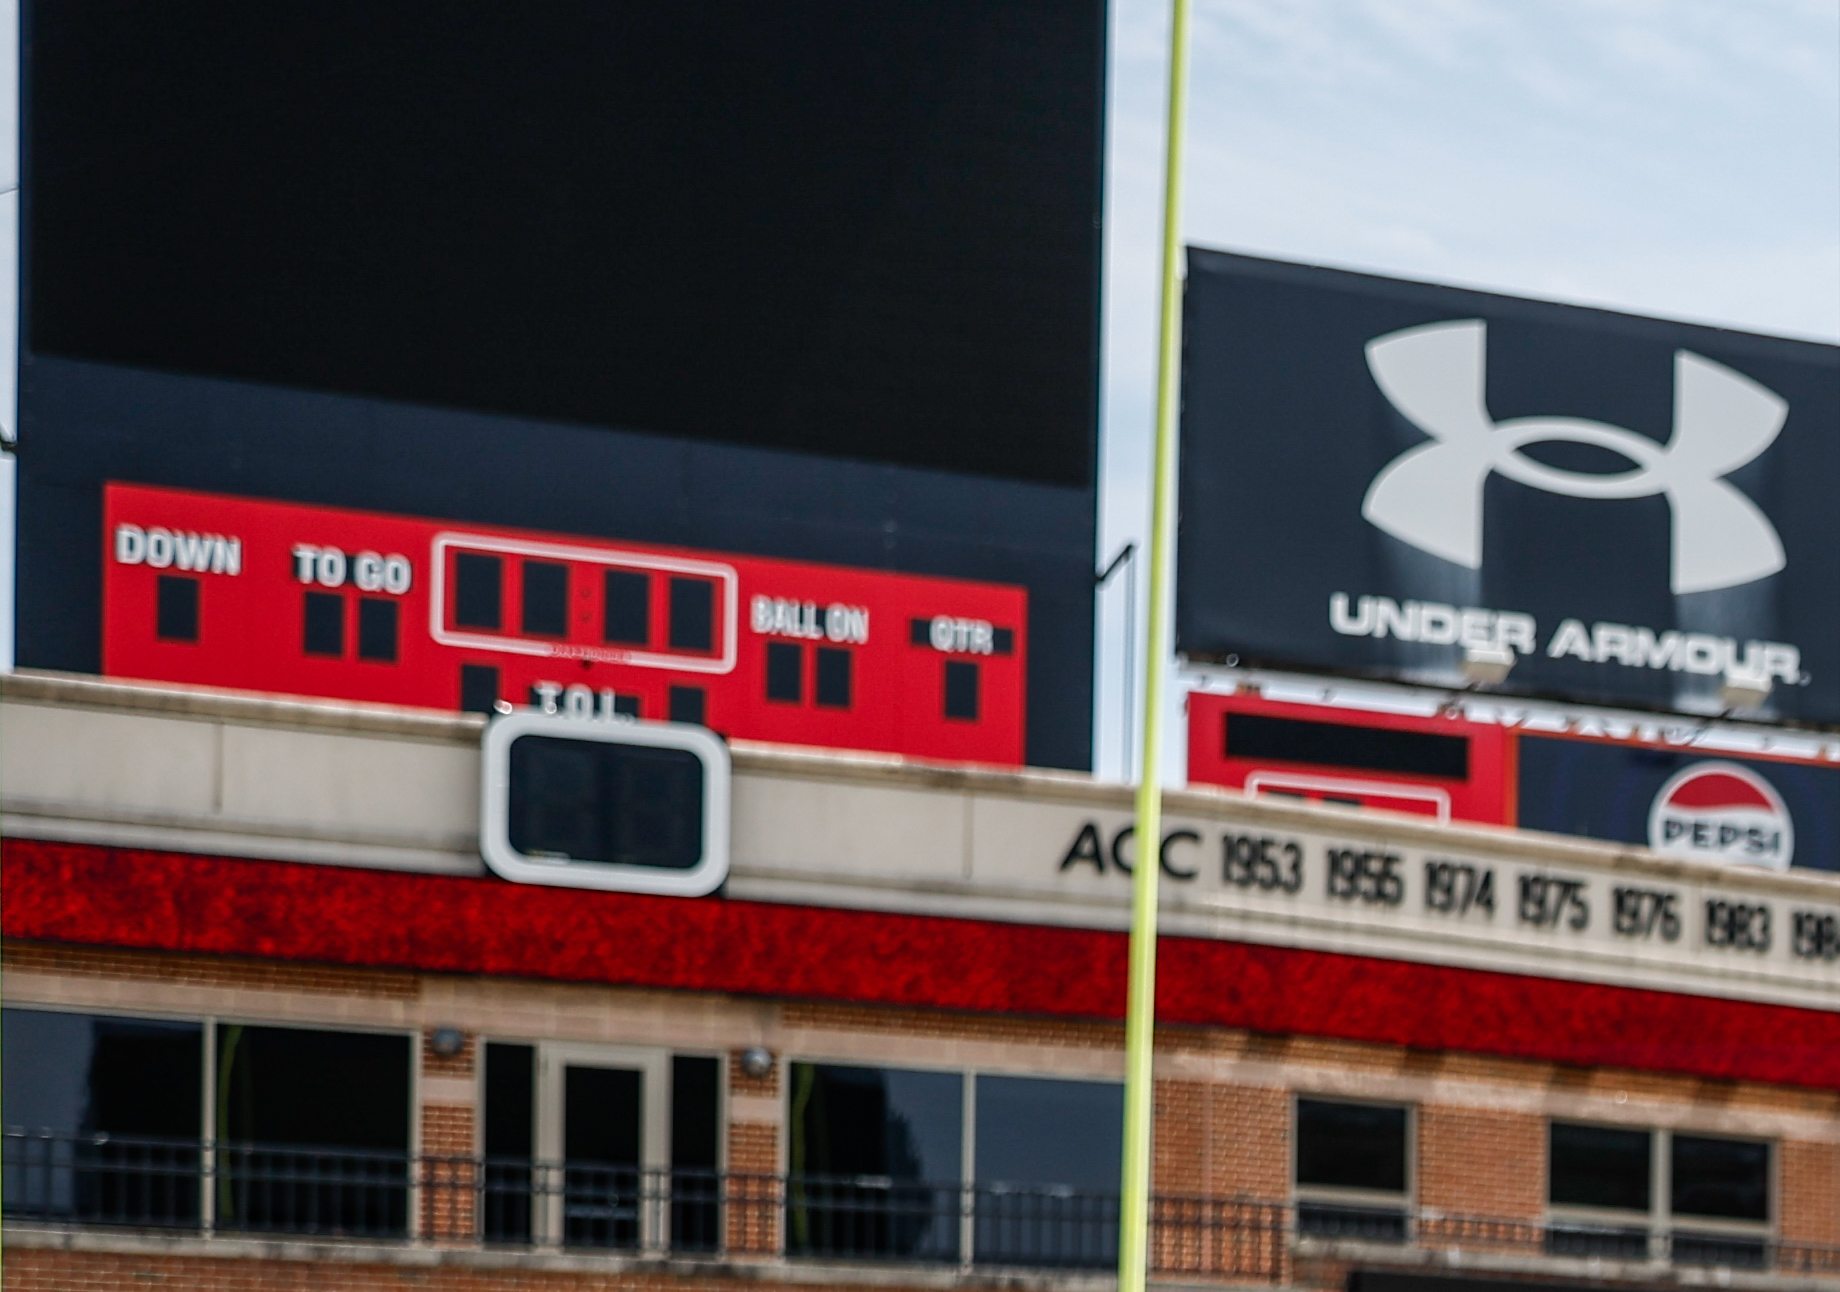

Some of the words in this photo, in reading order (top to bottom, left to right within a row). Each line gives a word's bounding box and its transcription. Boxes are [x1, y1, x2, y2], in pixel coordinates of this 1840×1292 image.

[115, 524, 243, 576] DOWN
[292, 544, 347, 588] TO
[354, 552, 412, 595] GO
[751, 595, 825, 639] BALL
[824, 602, 869, 644] ON
[928, 615, 994, 655] QTR
[1328, 592, 1537, 654] UNDER
[1664, 818, 1782, 855] PEPSI
[1058, 822, 1203, 880] ACC
[1221, 835, 1303, 894] 1953
[1327, 848, 1405, 906] 1955
[1424, 860, 1495, 916] 1974
[1517, 873, 1590, 932] 1975
[1612, 886, 1682, 943] 1976
[1705, 900, 1772, 955] 1983
